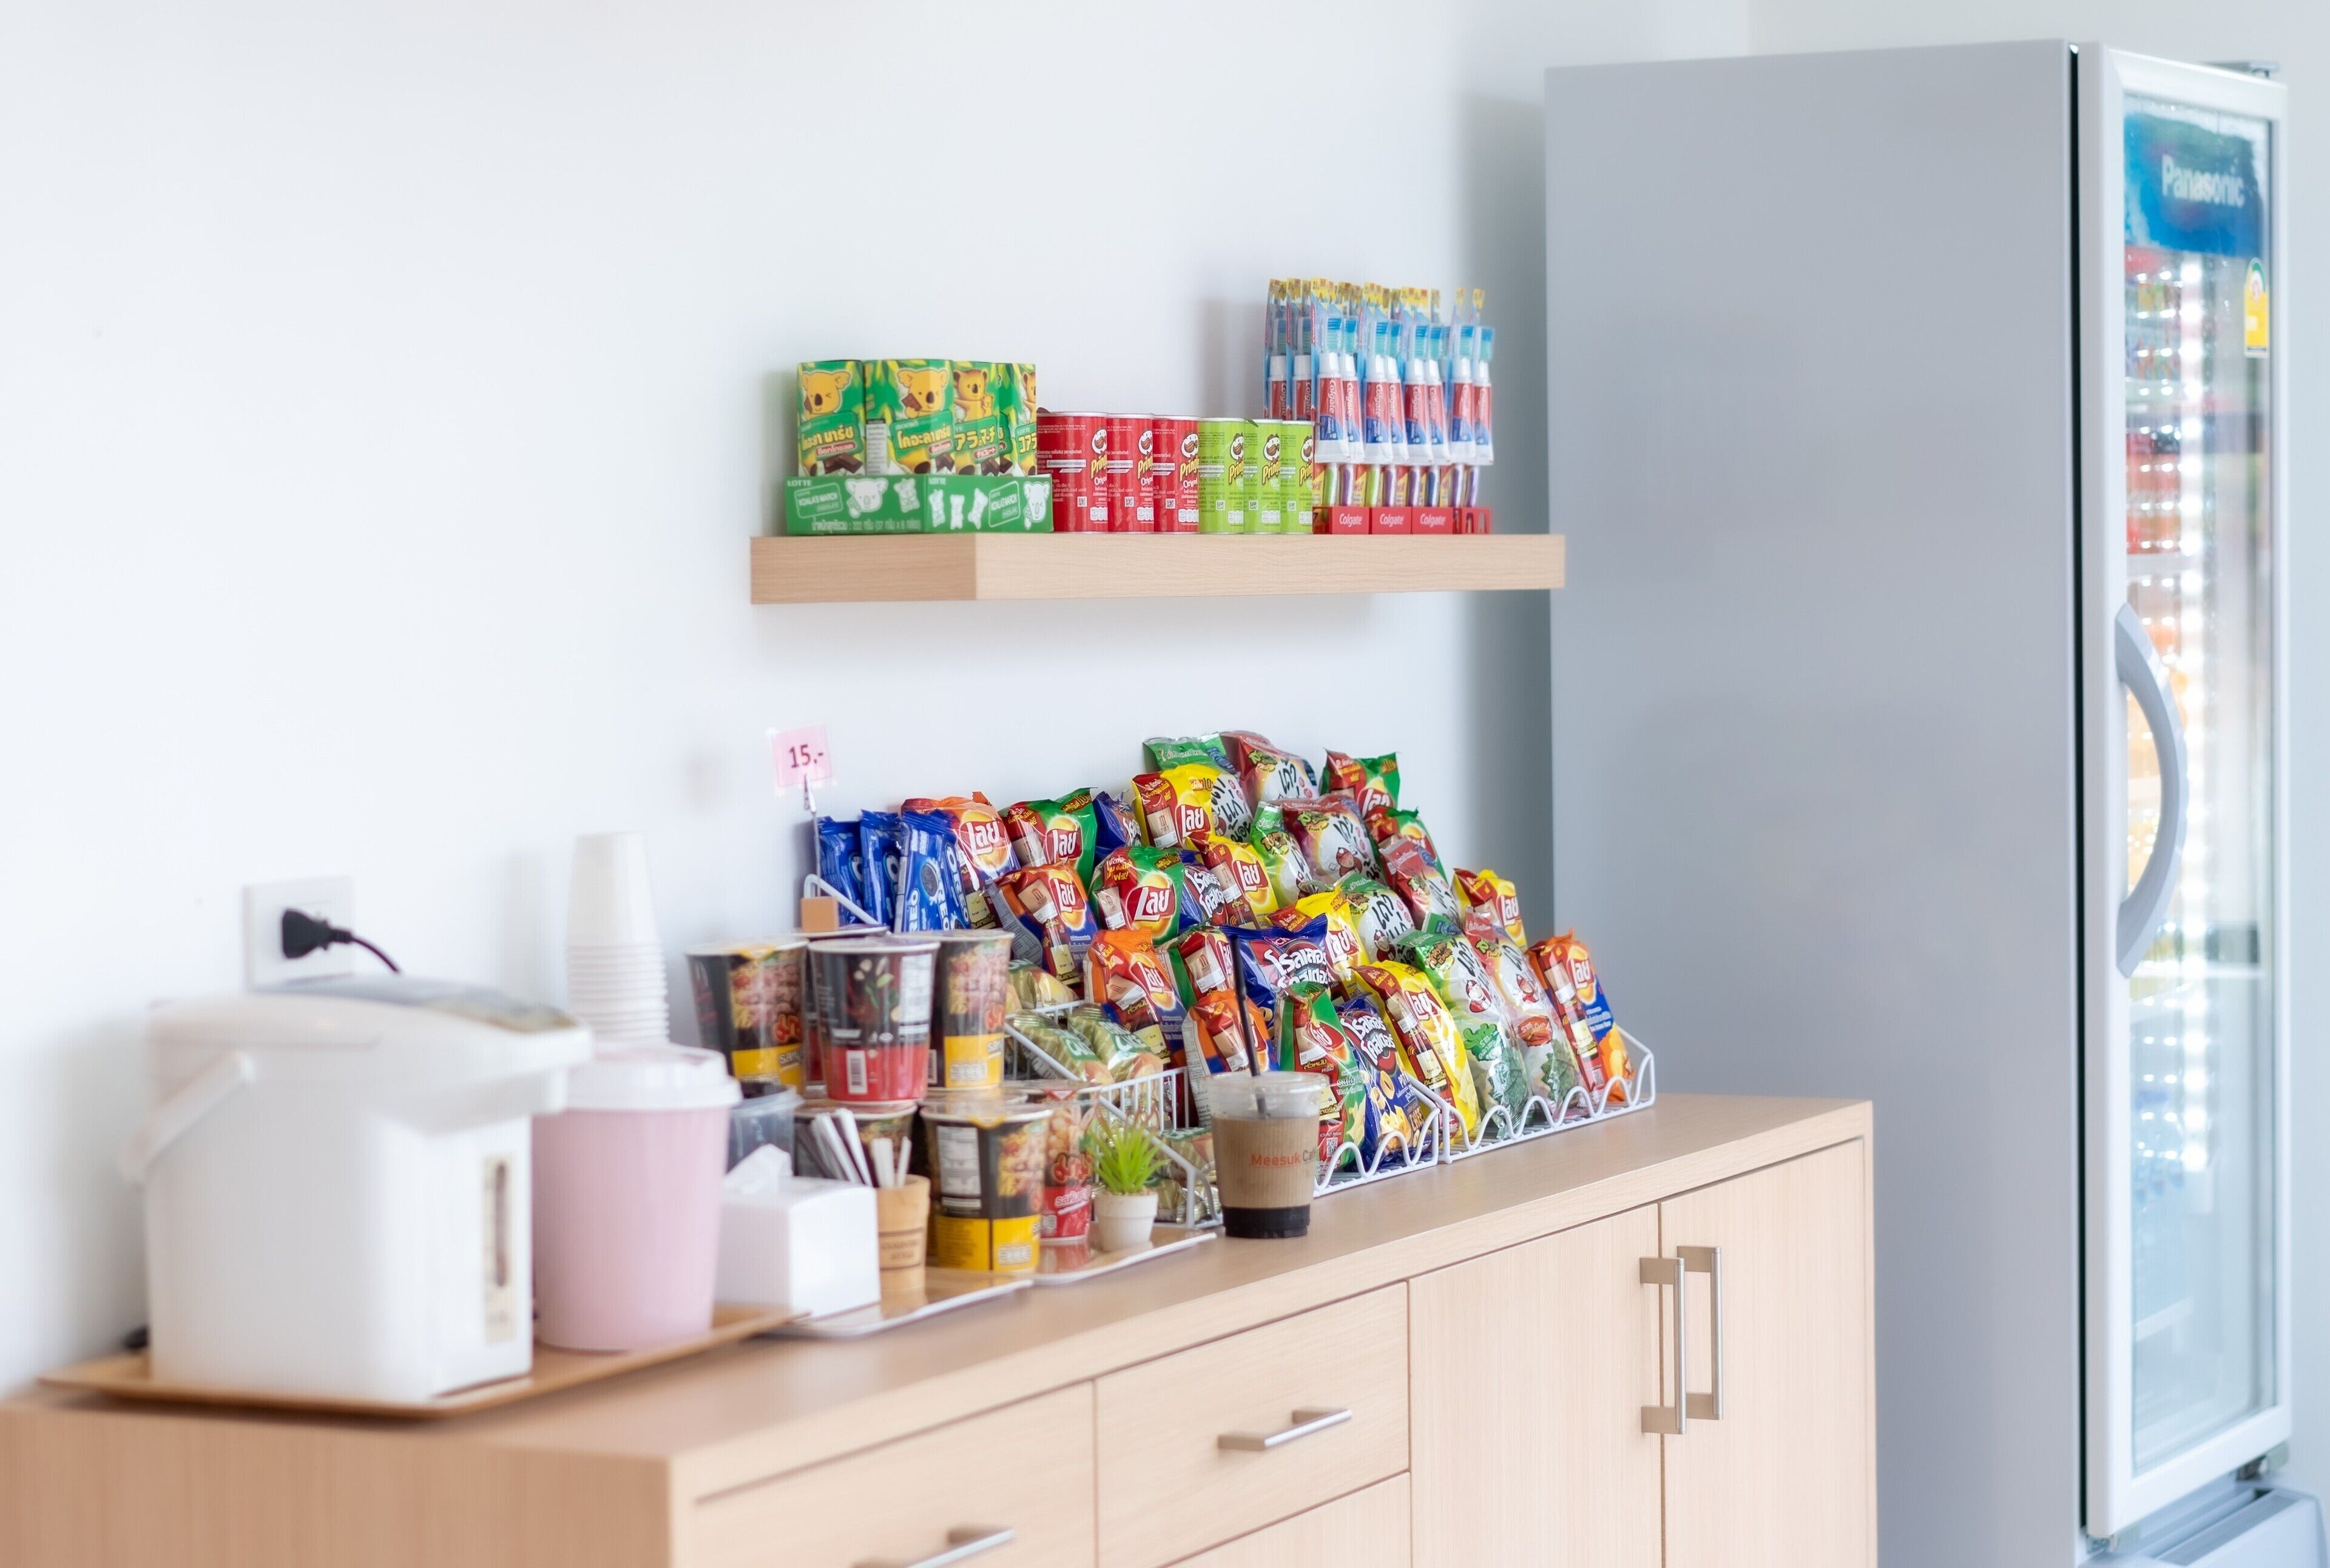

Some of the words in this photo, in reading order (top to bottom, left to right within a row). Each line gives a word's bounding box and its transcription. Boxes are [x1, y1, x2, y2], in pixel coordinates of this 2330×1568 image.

[2161, 154, 2244, 209] Panasonic
[1339, 513, 1362, 527] Colgate
[1379, 513, 1404, 528] Colgate
[1420, 513, 1447, 528] Colgate
[789, 744, 824, 769] 15.-
[945, 845, 970, 923] OREO
[1251, 1153, 1301, 1166] Meesuk
[1302, 1149, 1317, 1162] Caf
